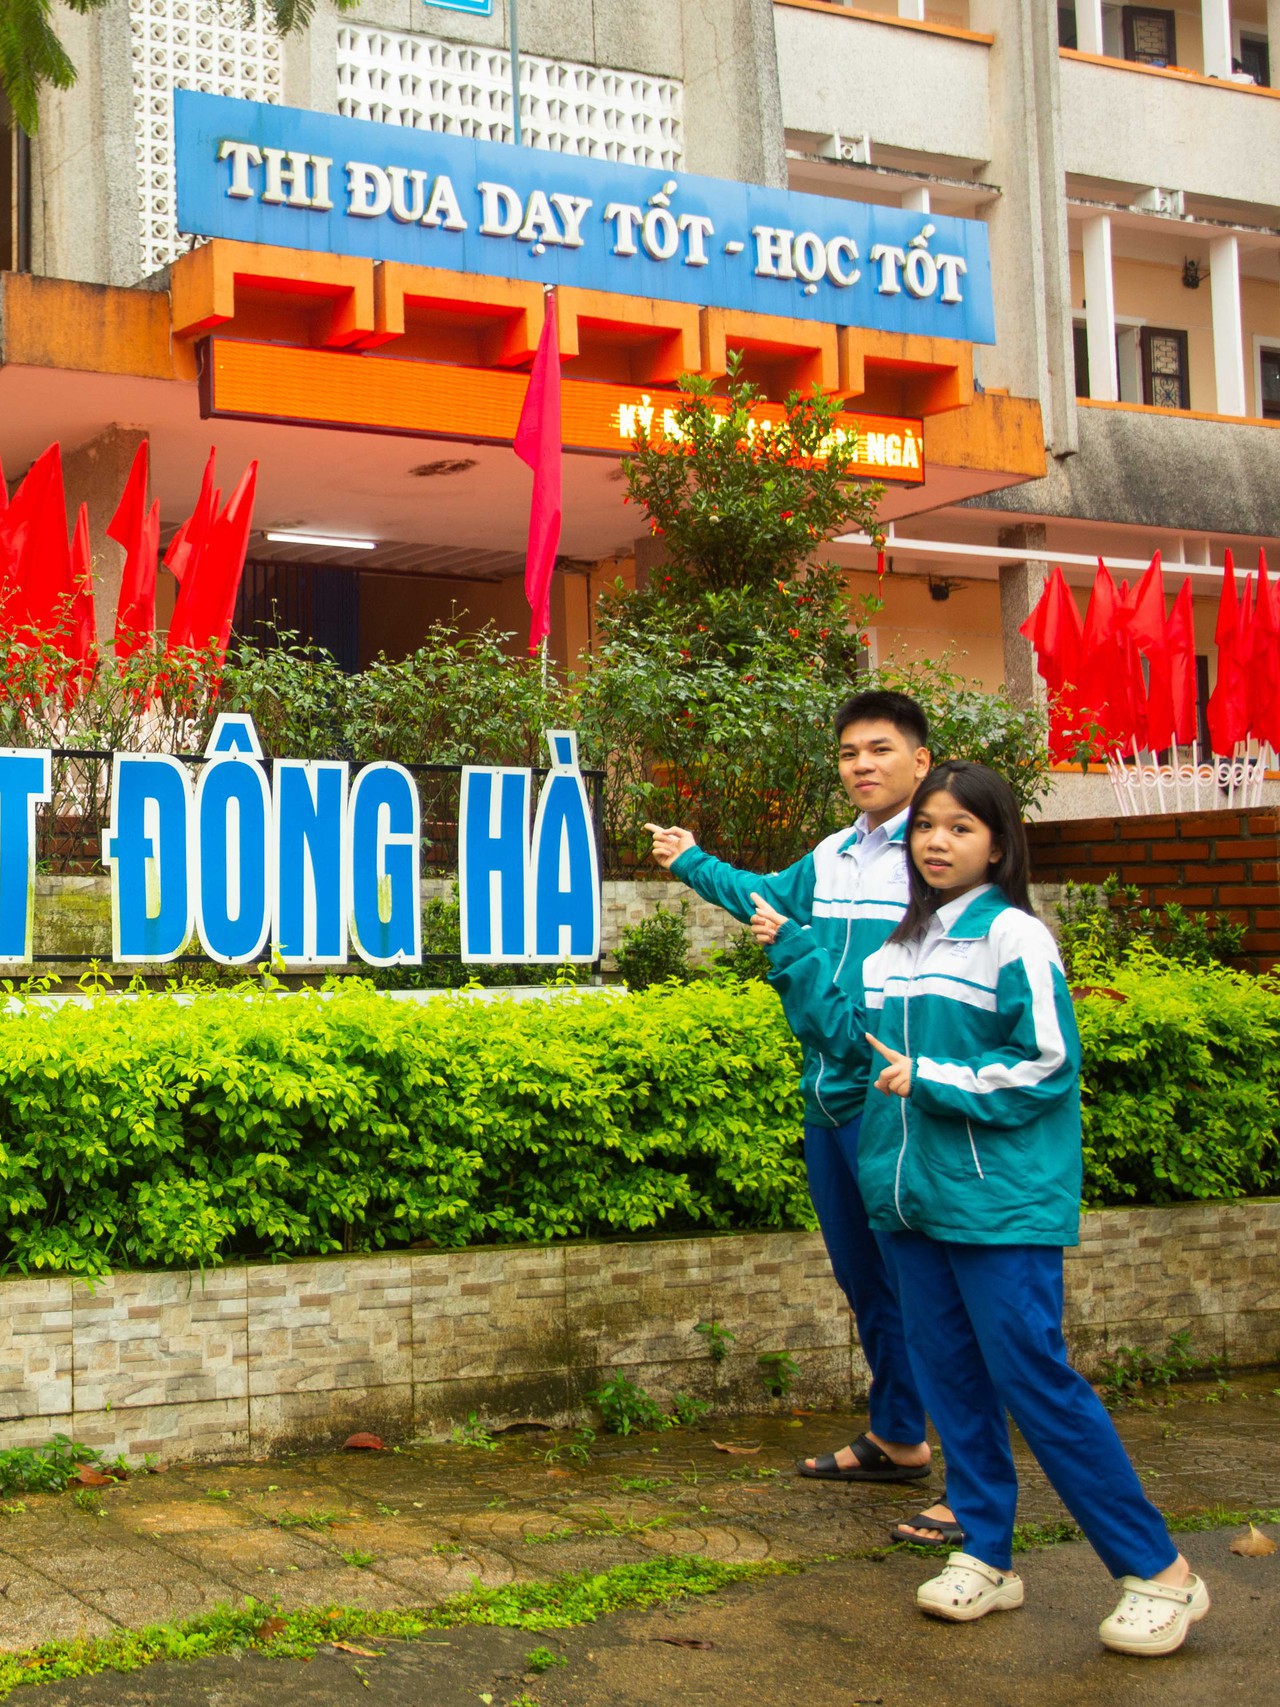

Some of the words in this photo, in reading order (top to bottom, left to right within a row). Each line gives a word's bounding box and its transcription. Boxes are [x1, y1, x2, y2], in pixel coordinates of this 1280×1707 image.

[218, 140, 334, 211] THI
[345, 161, 468, 232] ĐUA
[477, 181, 593, 258] DẠY
[604, 180, 715, 267] TỐT
[751, 225, 862, 297] HỌC
[870, 223, 968, 305] TỐT
[108, 721, 416, 959] ĐÔNG
[466, 735, 596, 957] HÀ
